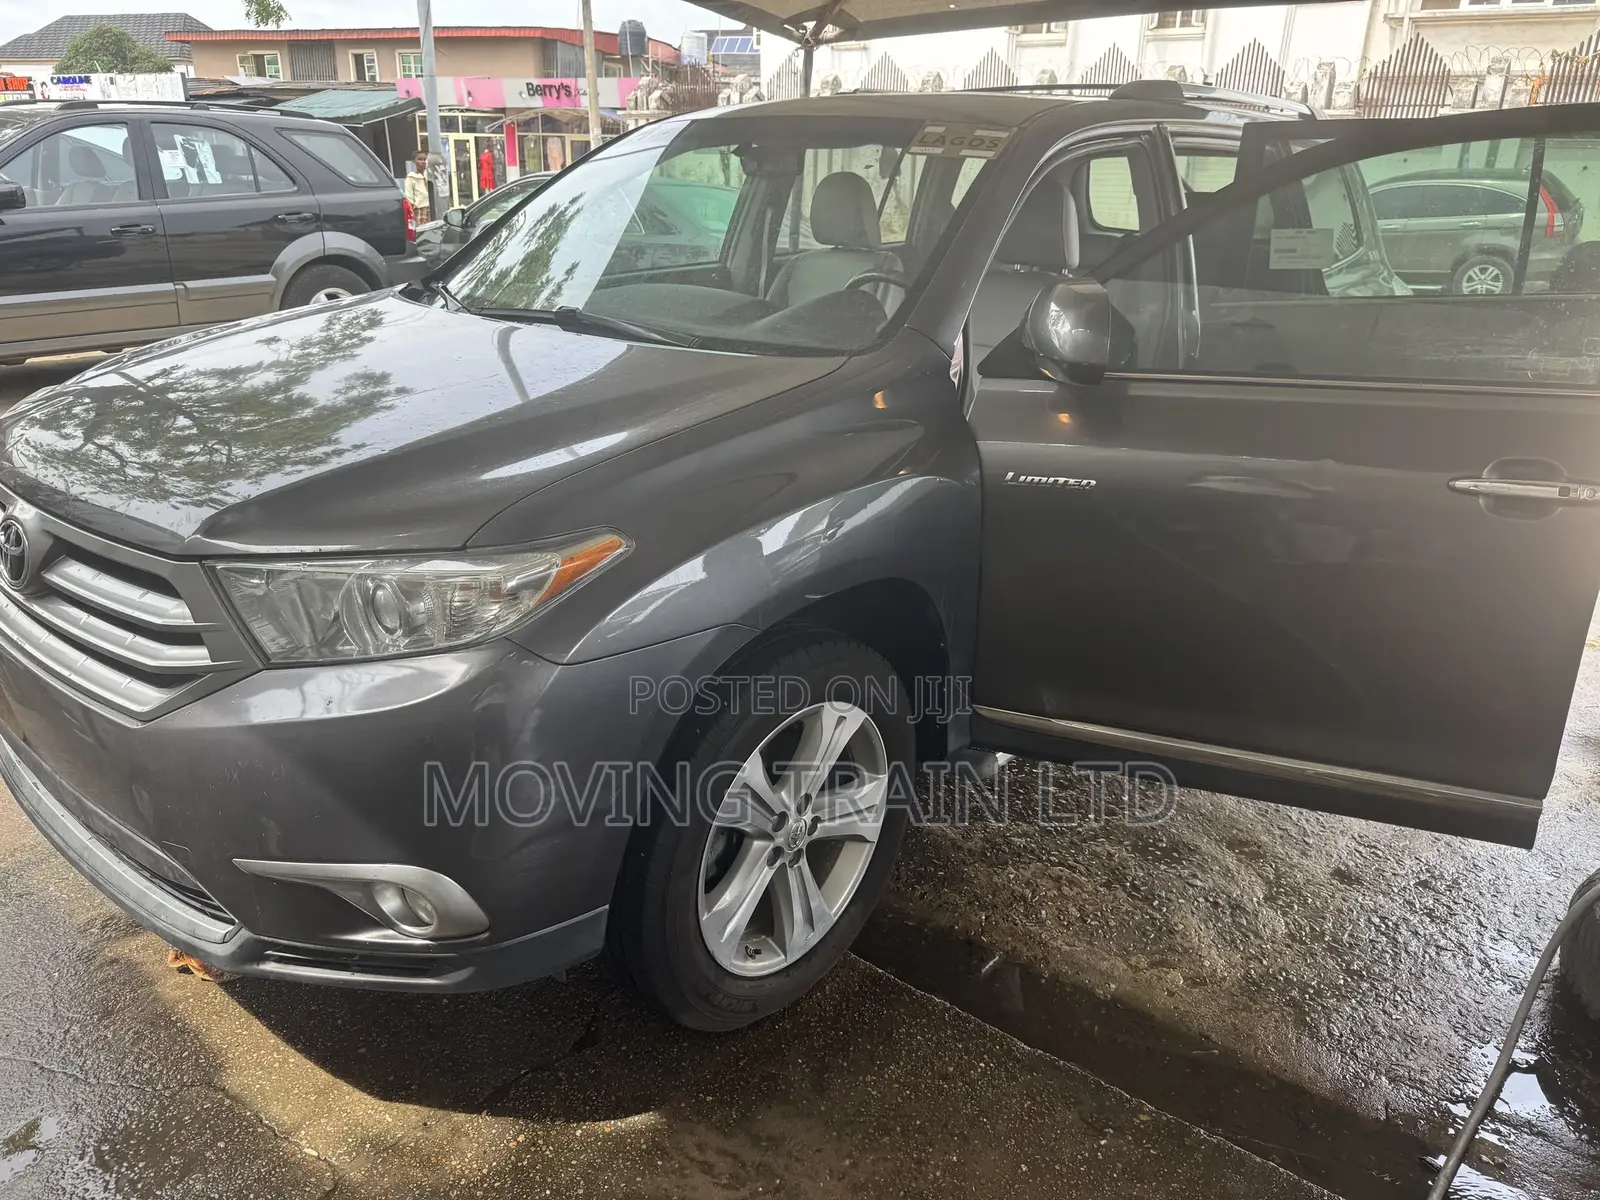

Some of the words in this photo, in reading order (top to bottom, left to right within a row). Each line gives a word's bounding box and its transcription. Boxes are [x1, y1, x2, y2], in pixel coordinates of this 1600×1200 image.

[6, 77, 28, 91] SHOP
[50, 75, 92, 85] CAROLINE
[526, 82, 572, 100] Berry's
[917, 134, 1002, 149] LAGOS
